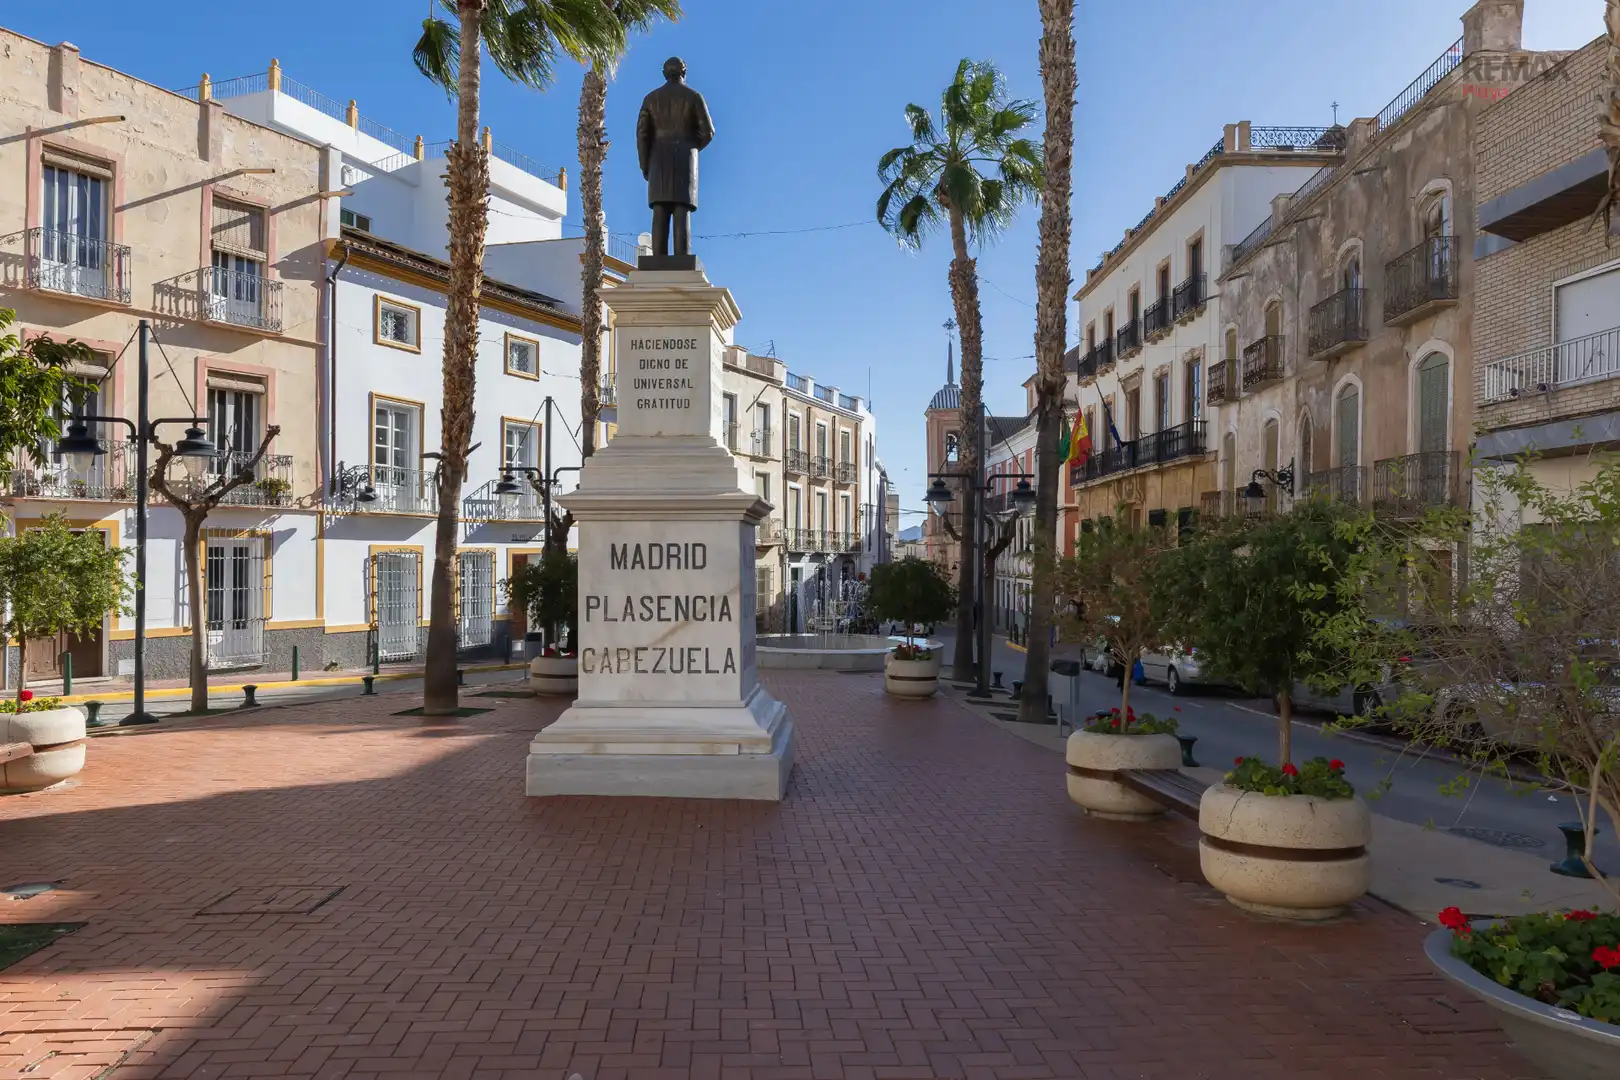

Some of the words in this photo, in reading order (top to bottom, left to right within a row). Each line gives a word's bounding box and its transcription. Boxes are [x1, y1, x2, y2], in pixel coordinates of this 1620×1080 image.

[630, 338, 697, 350] HACIENDOSE
[675, 358, 689, 370] DE
[633, 378, 694, 390] UNIVERSAL
[637, 398, 690, 410] GRATITUD
[611, 543, 707, 570] MADRID
[585, 595, 732, 622] PLASENCIA
[582, 647, 737, 674] CABEZUELA
